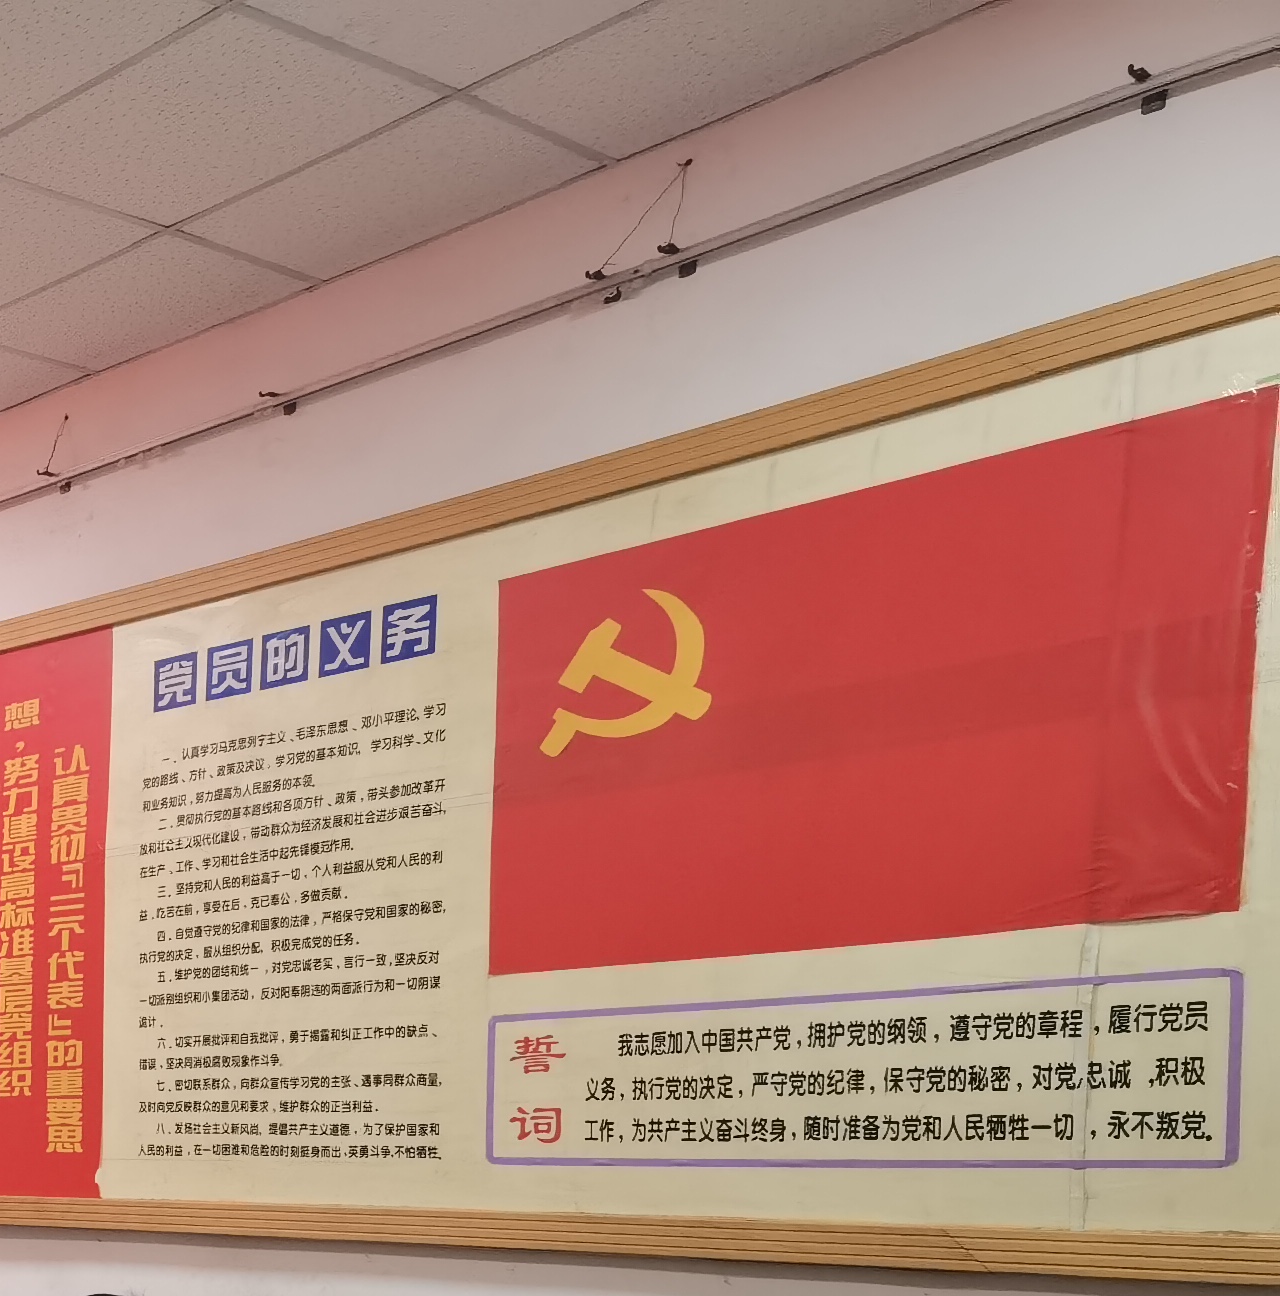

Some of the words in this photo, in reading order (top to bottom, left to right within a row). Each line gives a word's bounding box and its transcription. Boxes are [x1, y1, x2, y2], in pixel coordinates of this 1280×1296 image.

[156, 605, 433, 708] 党员的义务
